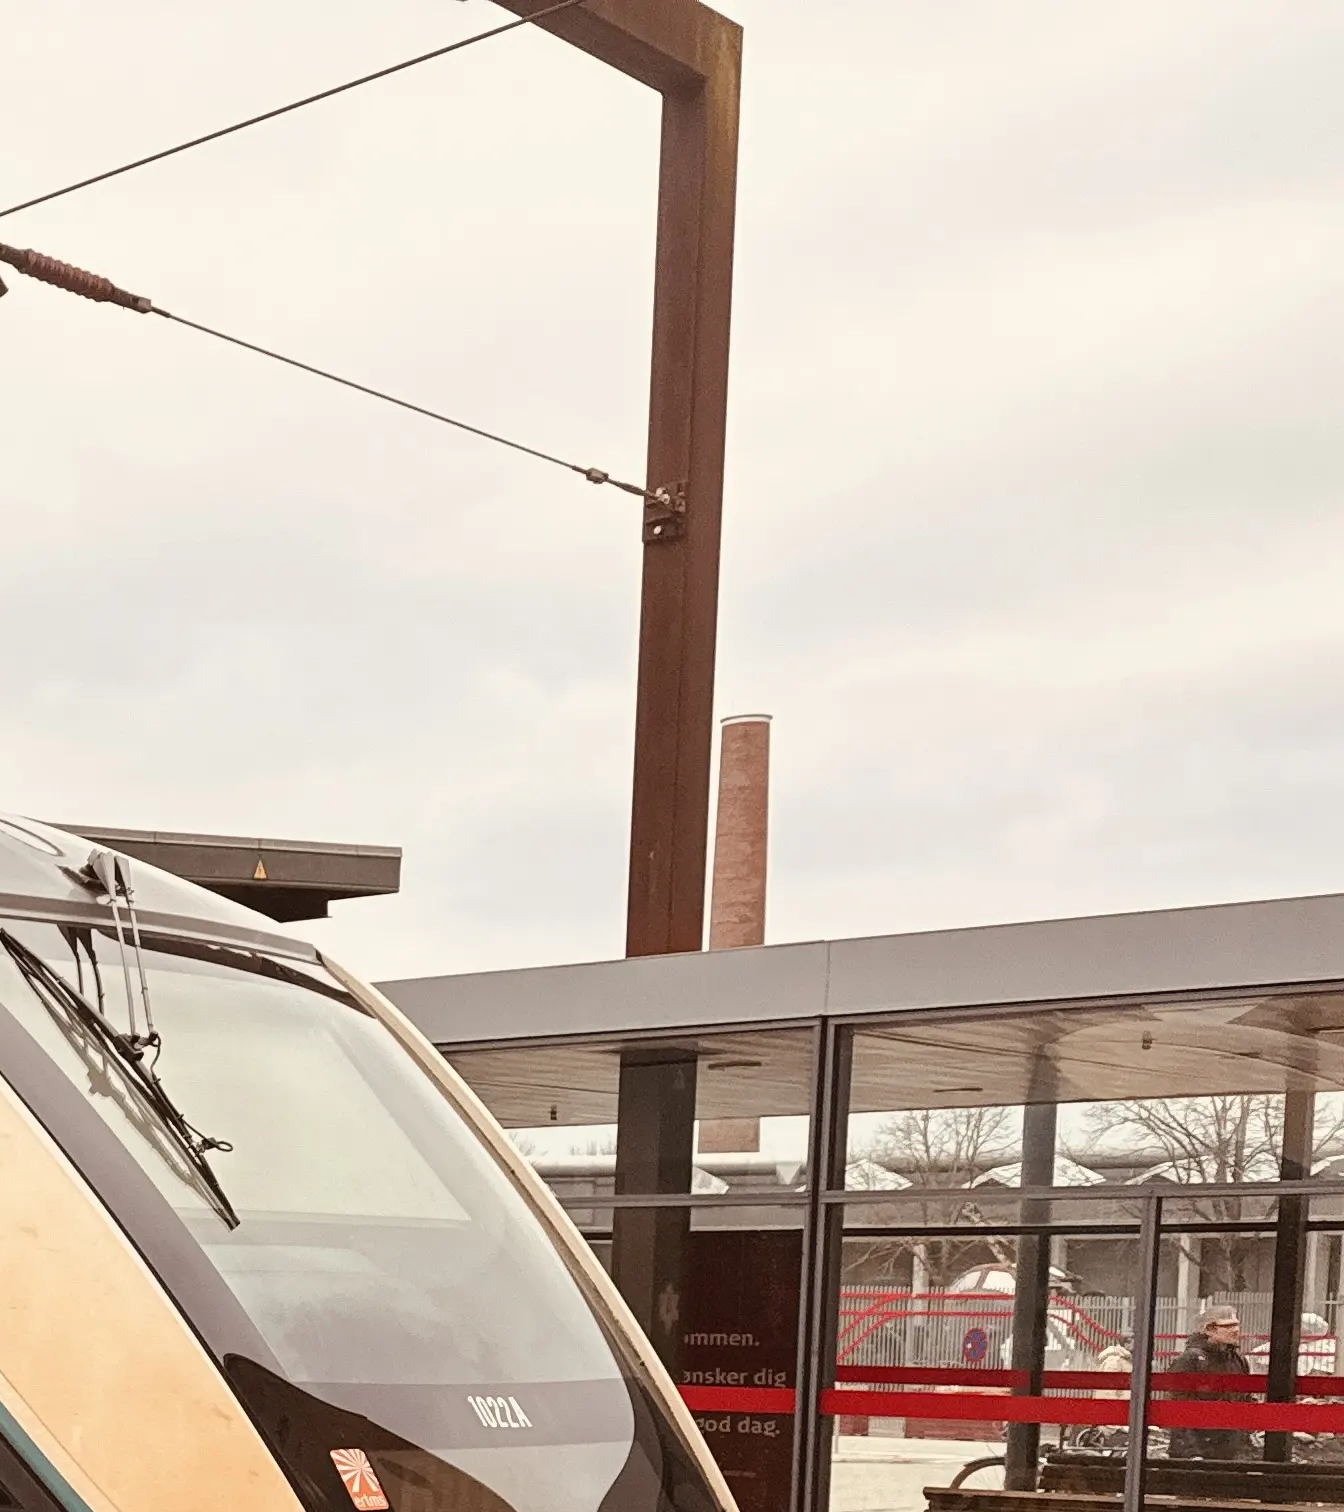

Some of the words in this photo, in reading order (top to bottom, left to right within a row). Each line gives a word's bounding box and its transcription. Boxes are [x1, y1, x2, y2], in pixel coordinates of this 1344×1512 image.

[753, 1367, 788, 1388] dig
[467, 1395, 533, 1428] 1022A
[737, 1415, 781, 1438] dag.
